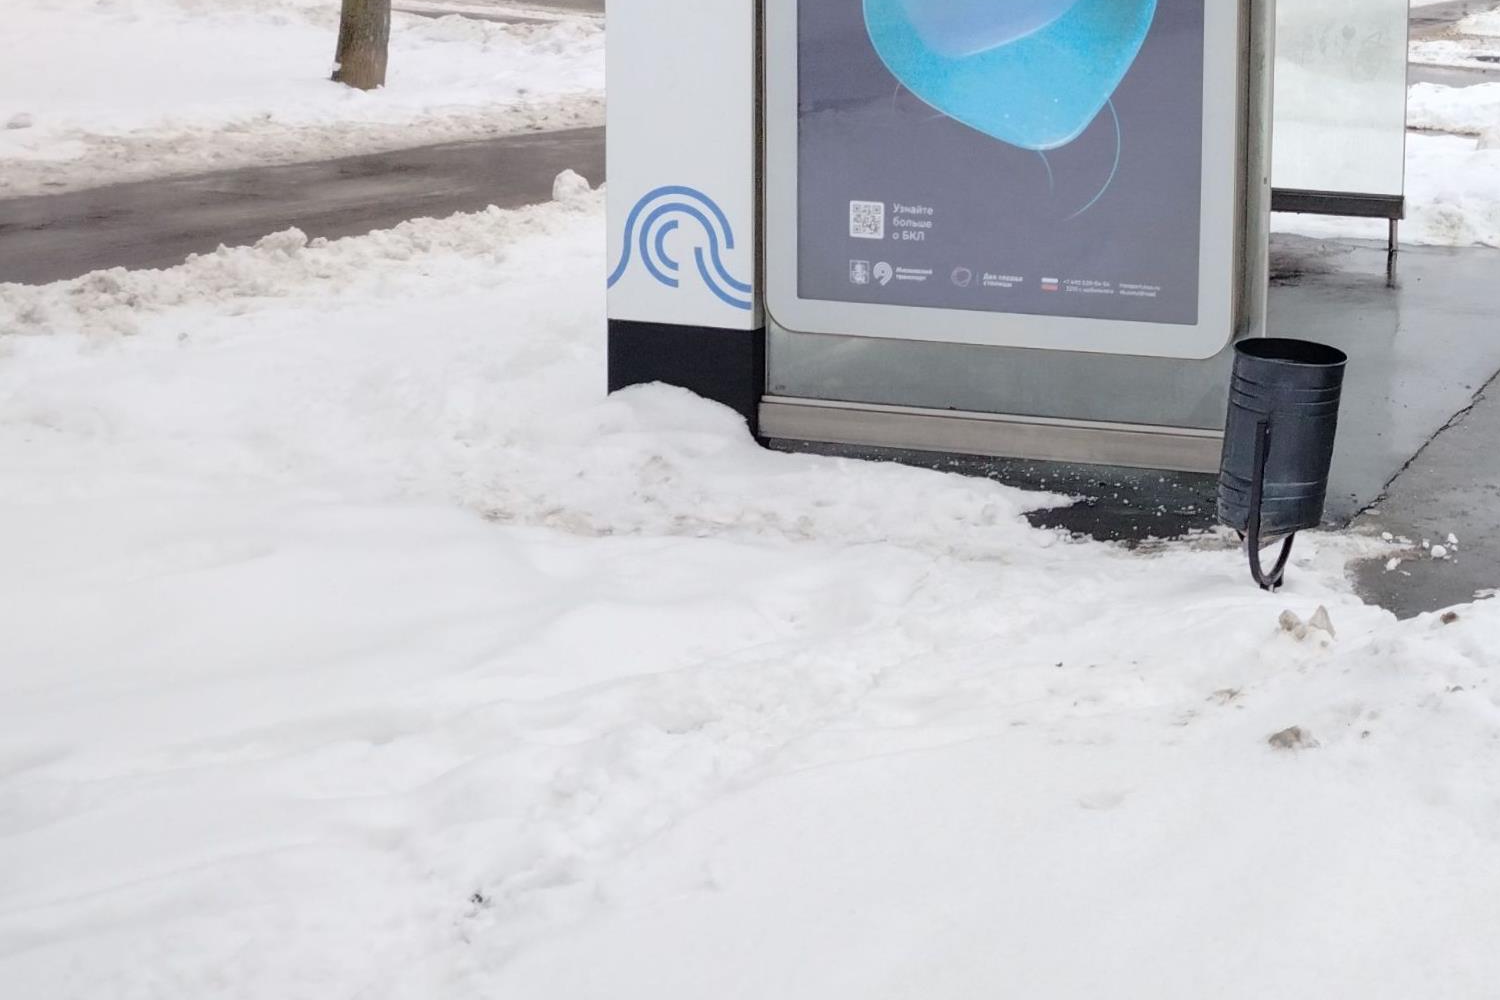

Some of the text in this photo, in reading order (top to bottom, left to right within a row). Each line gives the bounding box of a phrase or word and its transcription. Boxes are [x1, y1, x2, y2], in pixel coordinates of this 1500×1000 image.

[892, 202, 934, 216] Узнайте
[892, 216, 932, 229] больше
[892, 230, 925, 241] о БКЛ
